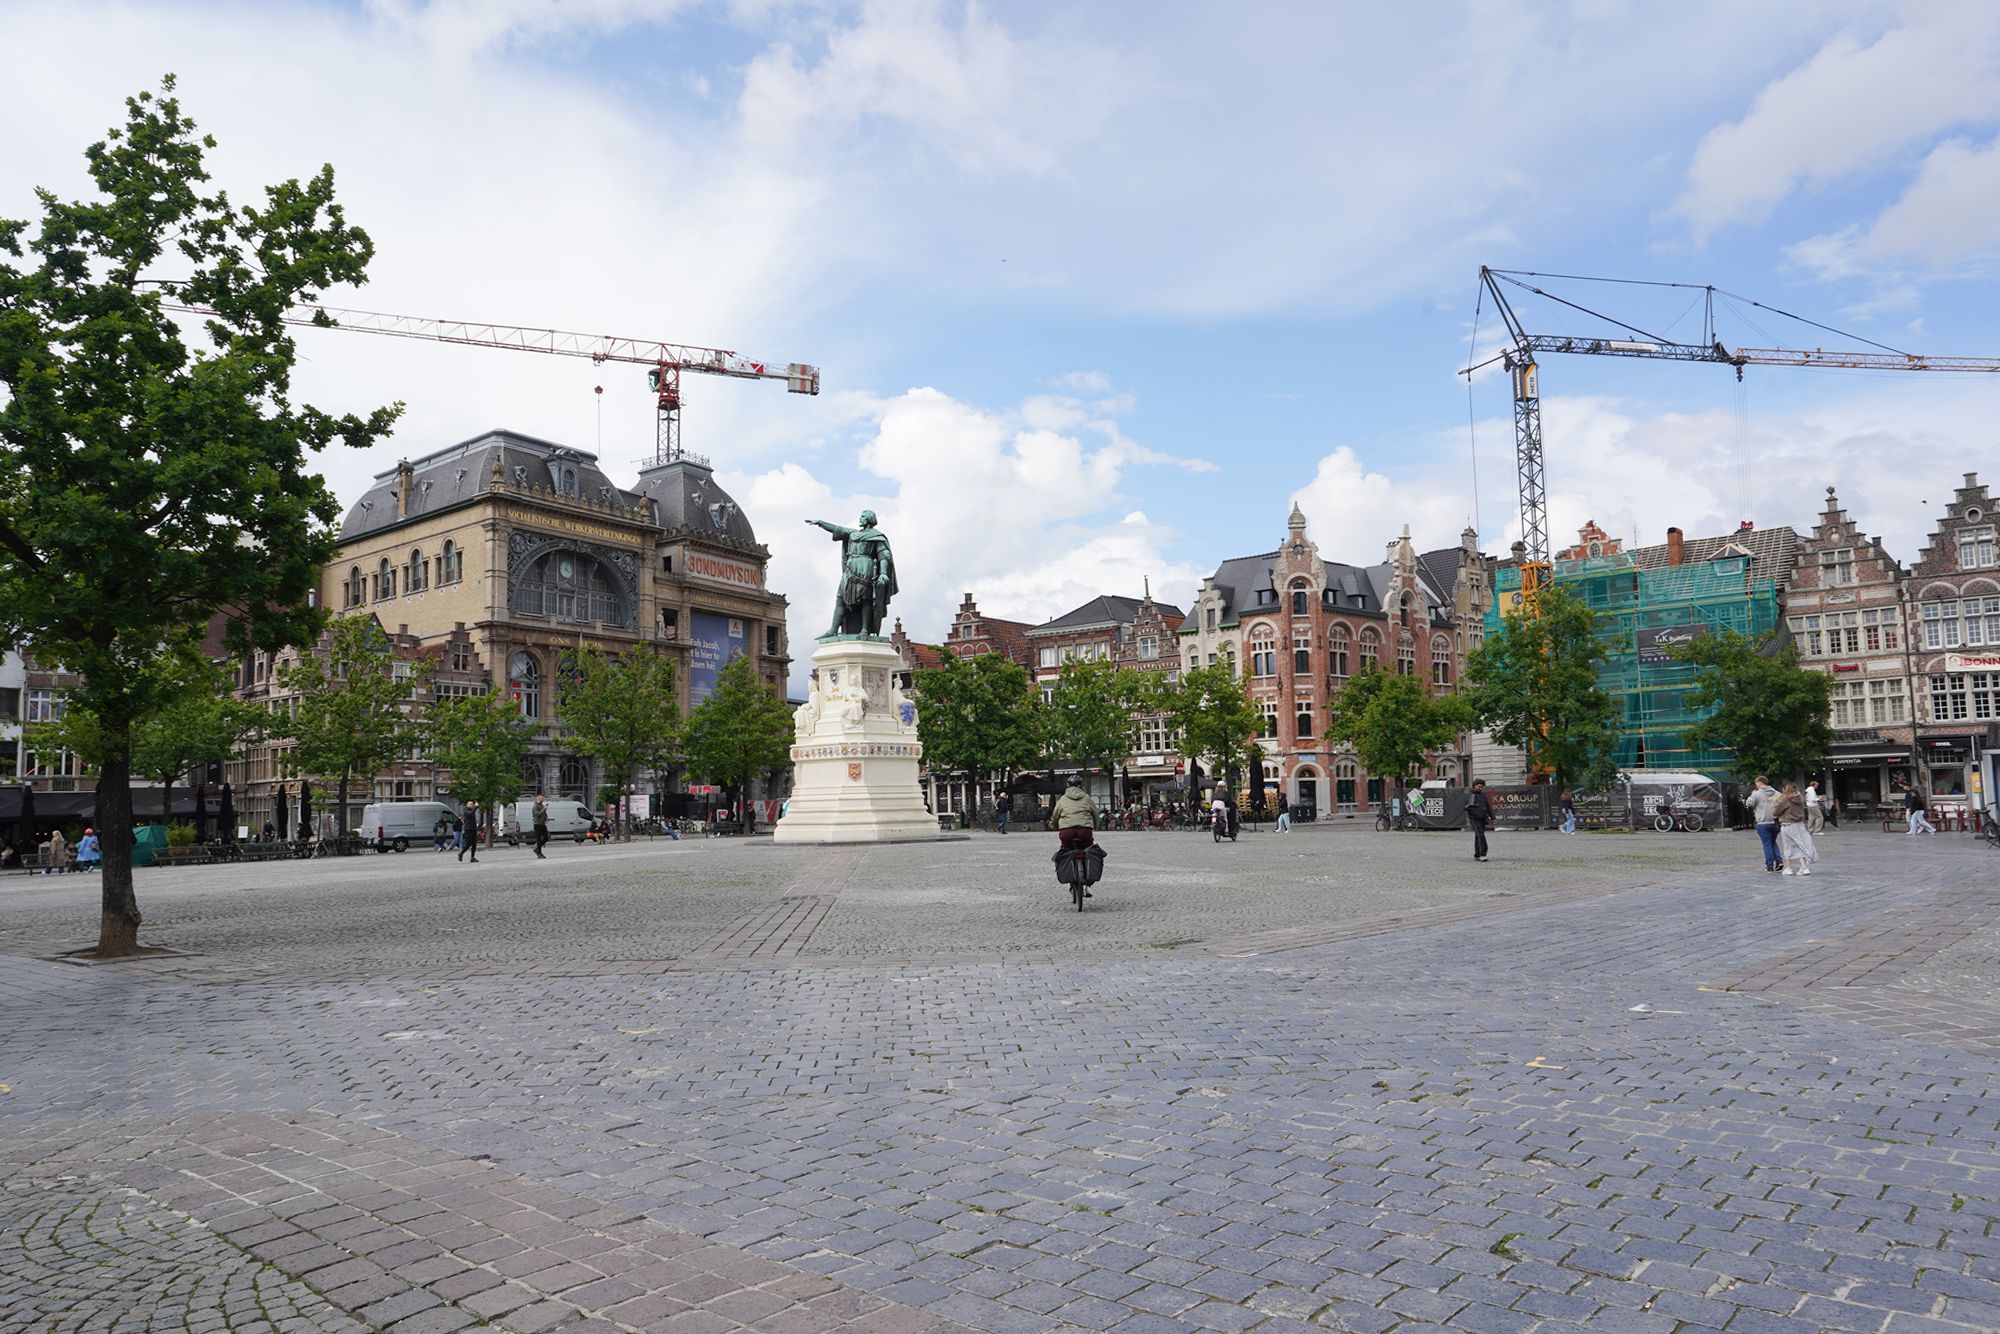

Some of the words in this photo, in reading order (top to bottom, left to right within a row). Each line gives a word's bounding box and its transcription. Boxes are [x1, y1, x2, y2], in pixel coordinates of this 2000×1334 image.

[508, 509, 560, 528] SOCIALISTISCHE
[550, 636, 570, 645] ONS
[1507, 794, 1538, 802] GROUP
[1643, 797, 1665, 805] ARCH
[1426, 799, 1444, 807] ARCH
